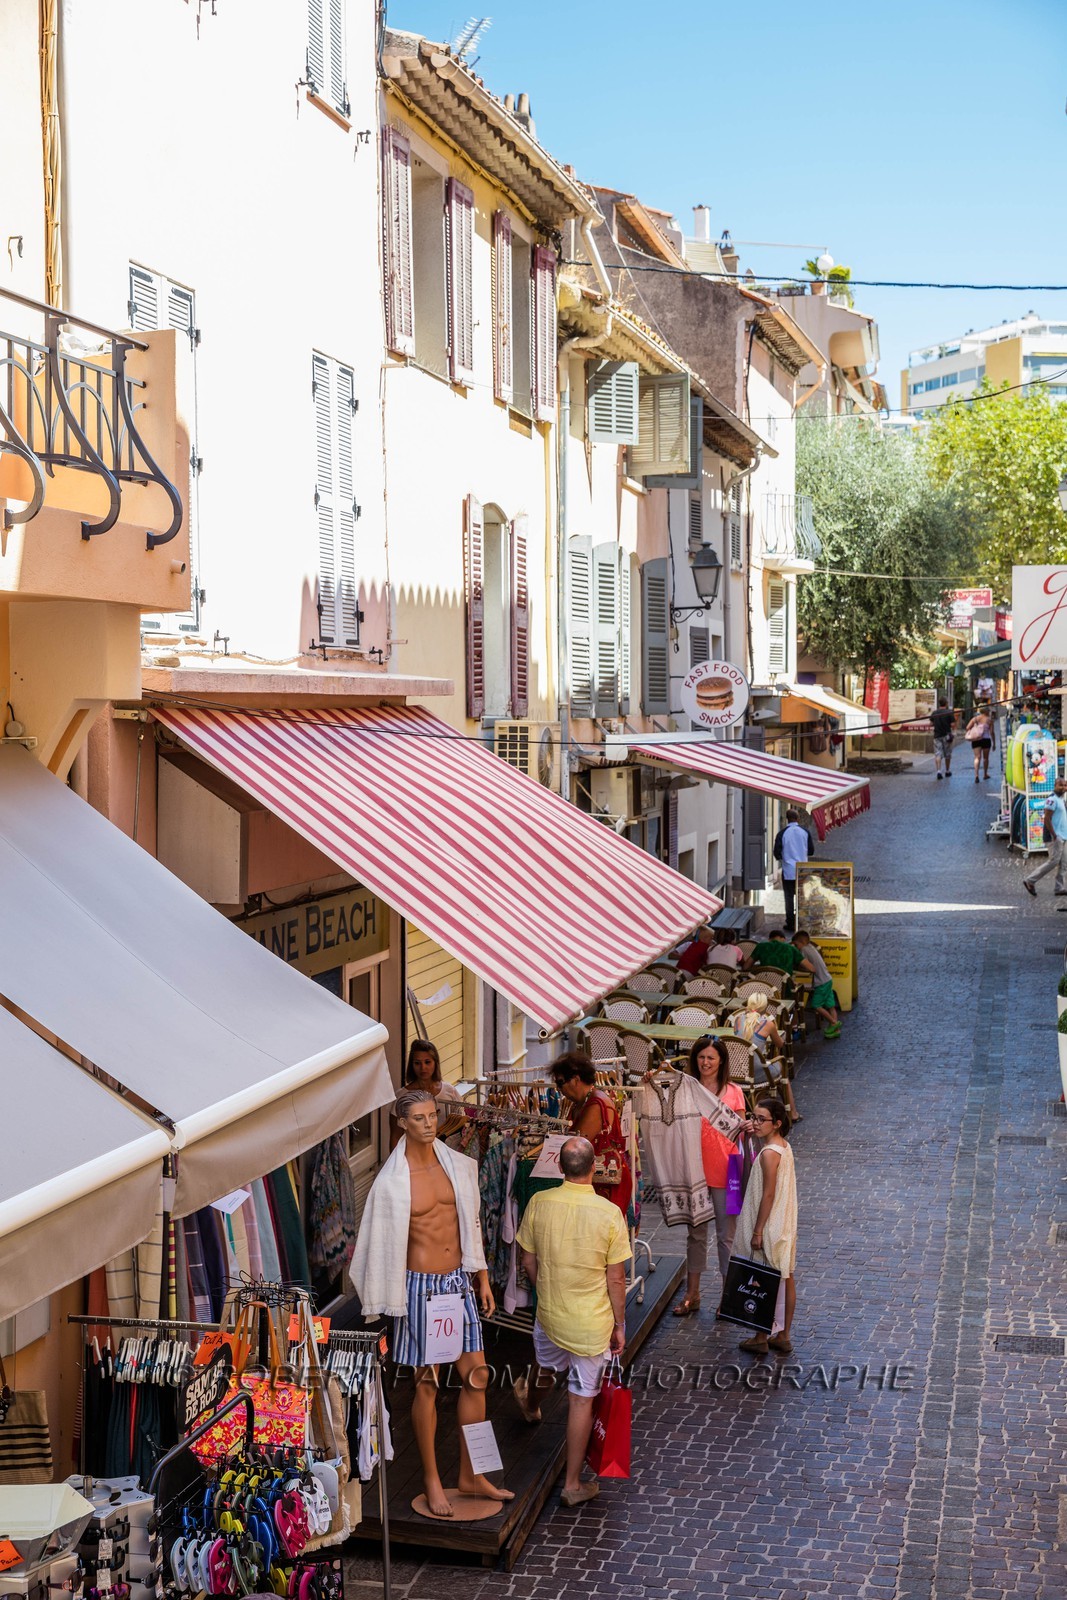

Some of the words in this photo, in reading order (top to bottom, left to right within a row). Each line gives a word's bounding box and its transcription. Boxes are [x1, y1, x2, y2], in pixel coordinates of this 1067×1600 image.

[684, 664, 708, 689] FAST
[713, 663, 744, 686] FOOD
[698, 710, 735, 725] SNACK
[305, 898, 376, 955] BEACH
